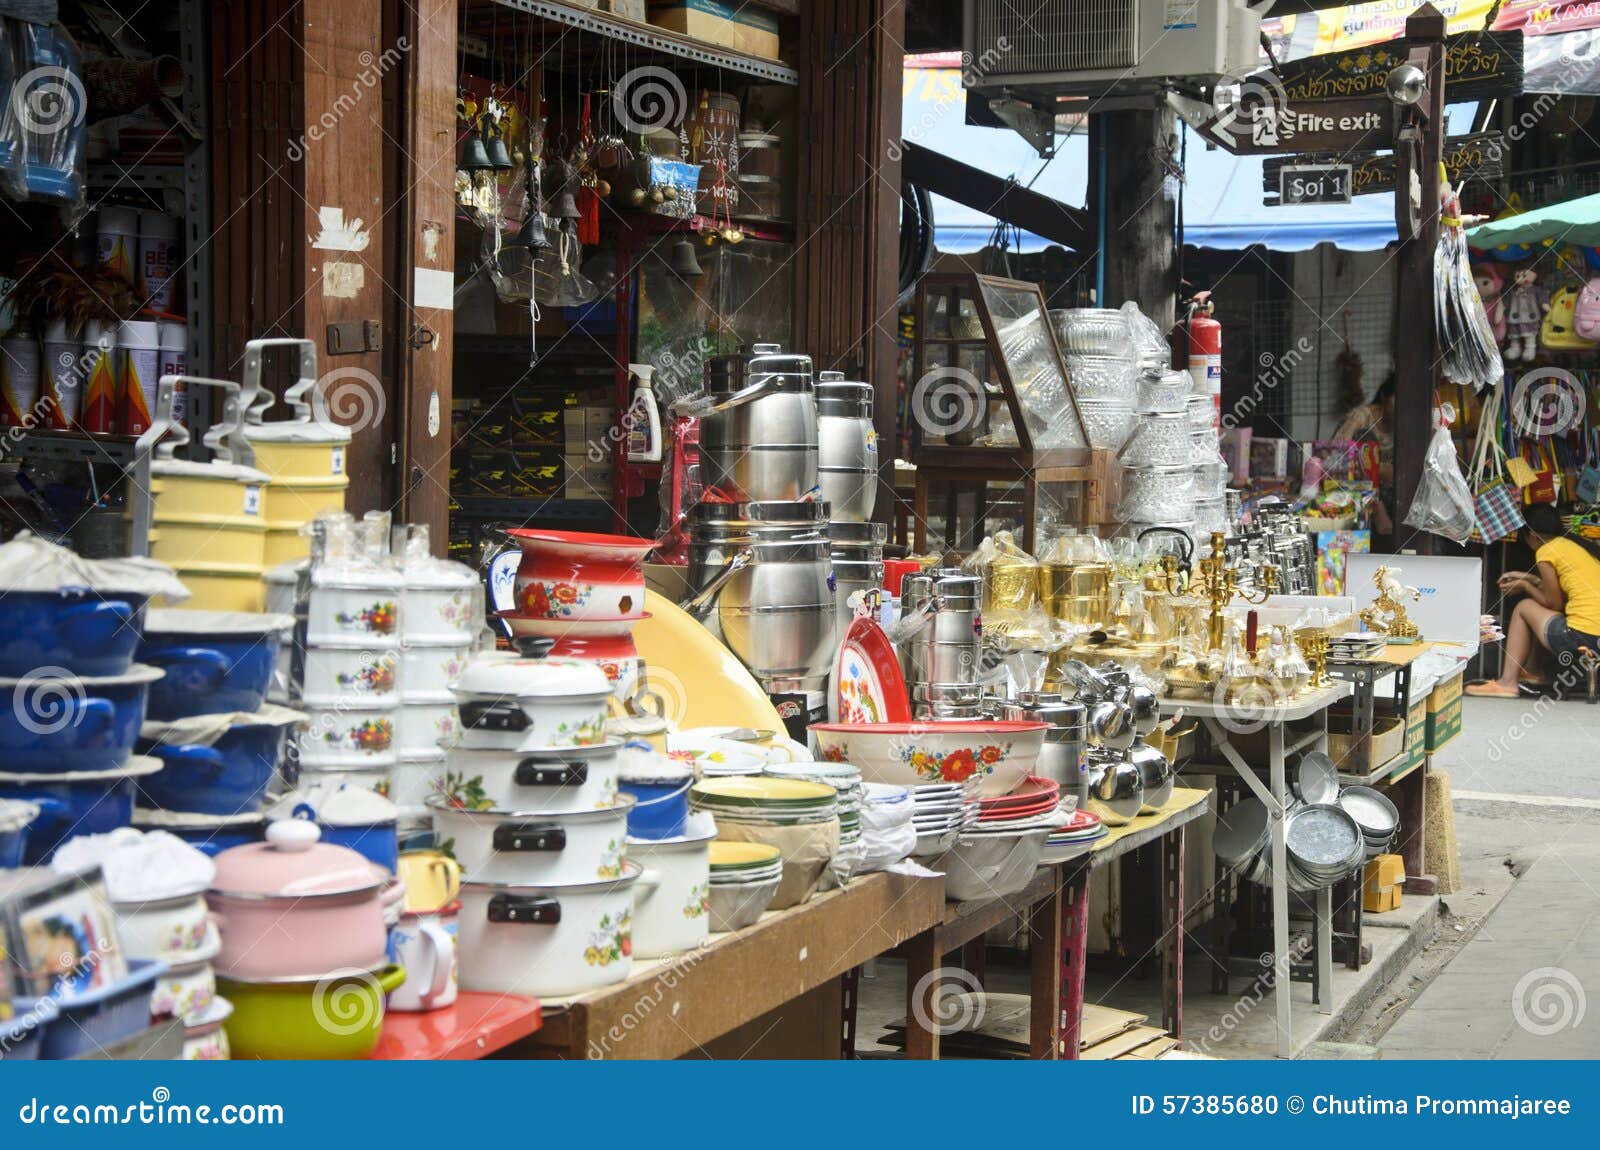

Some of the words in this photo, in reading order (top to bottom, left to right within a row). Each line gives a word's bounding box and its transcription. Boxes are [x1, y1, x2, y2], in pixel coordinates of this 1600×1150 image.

[1297, 113, 1334, 131] Fire
[1339, 112, 1381, 130] exit
[1293, 178, 1324, 196] Soi
[1332, 177, 1343, 195] 1
